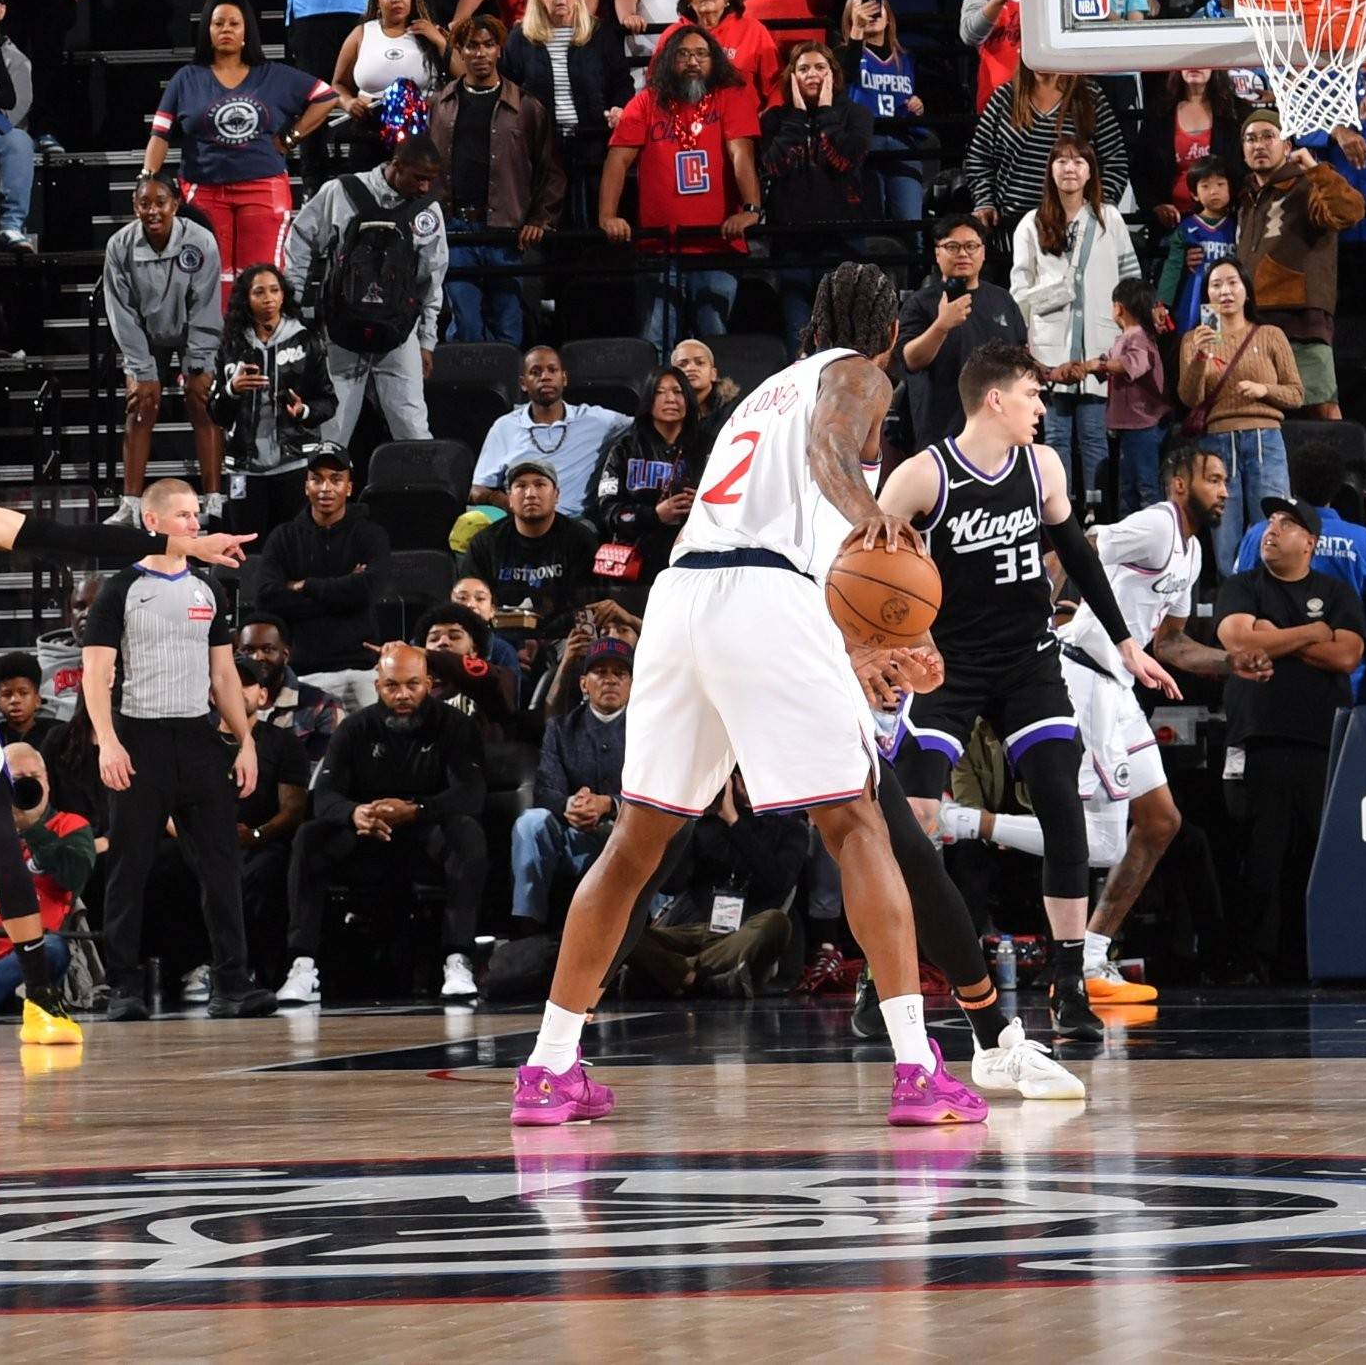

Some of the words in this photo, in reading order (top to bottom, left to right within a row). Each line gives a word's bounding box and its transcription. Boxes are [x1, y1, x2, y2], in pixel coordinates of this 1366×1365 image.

[1077, 0, 1098, 16] NBA
[859, 68, 914, 95] CLIPPERS
[878, 93, 896, 118] 13
[701, 430, 761, 506] 2
[946, 506, 1036, 555] Kings
[993, 542, 1043, 586] 33
